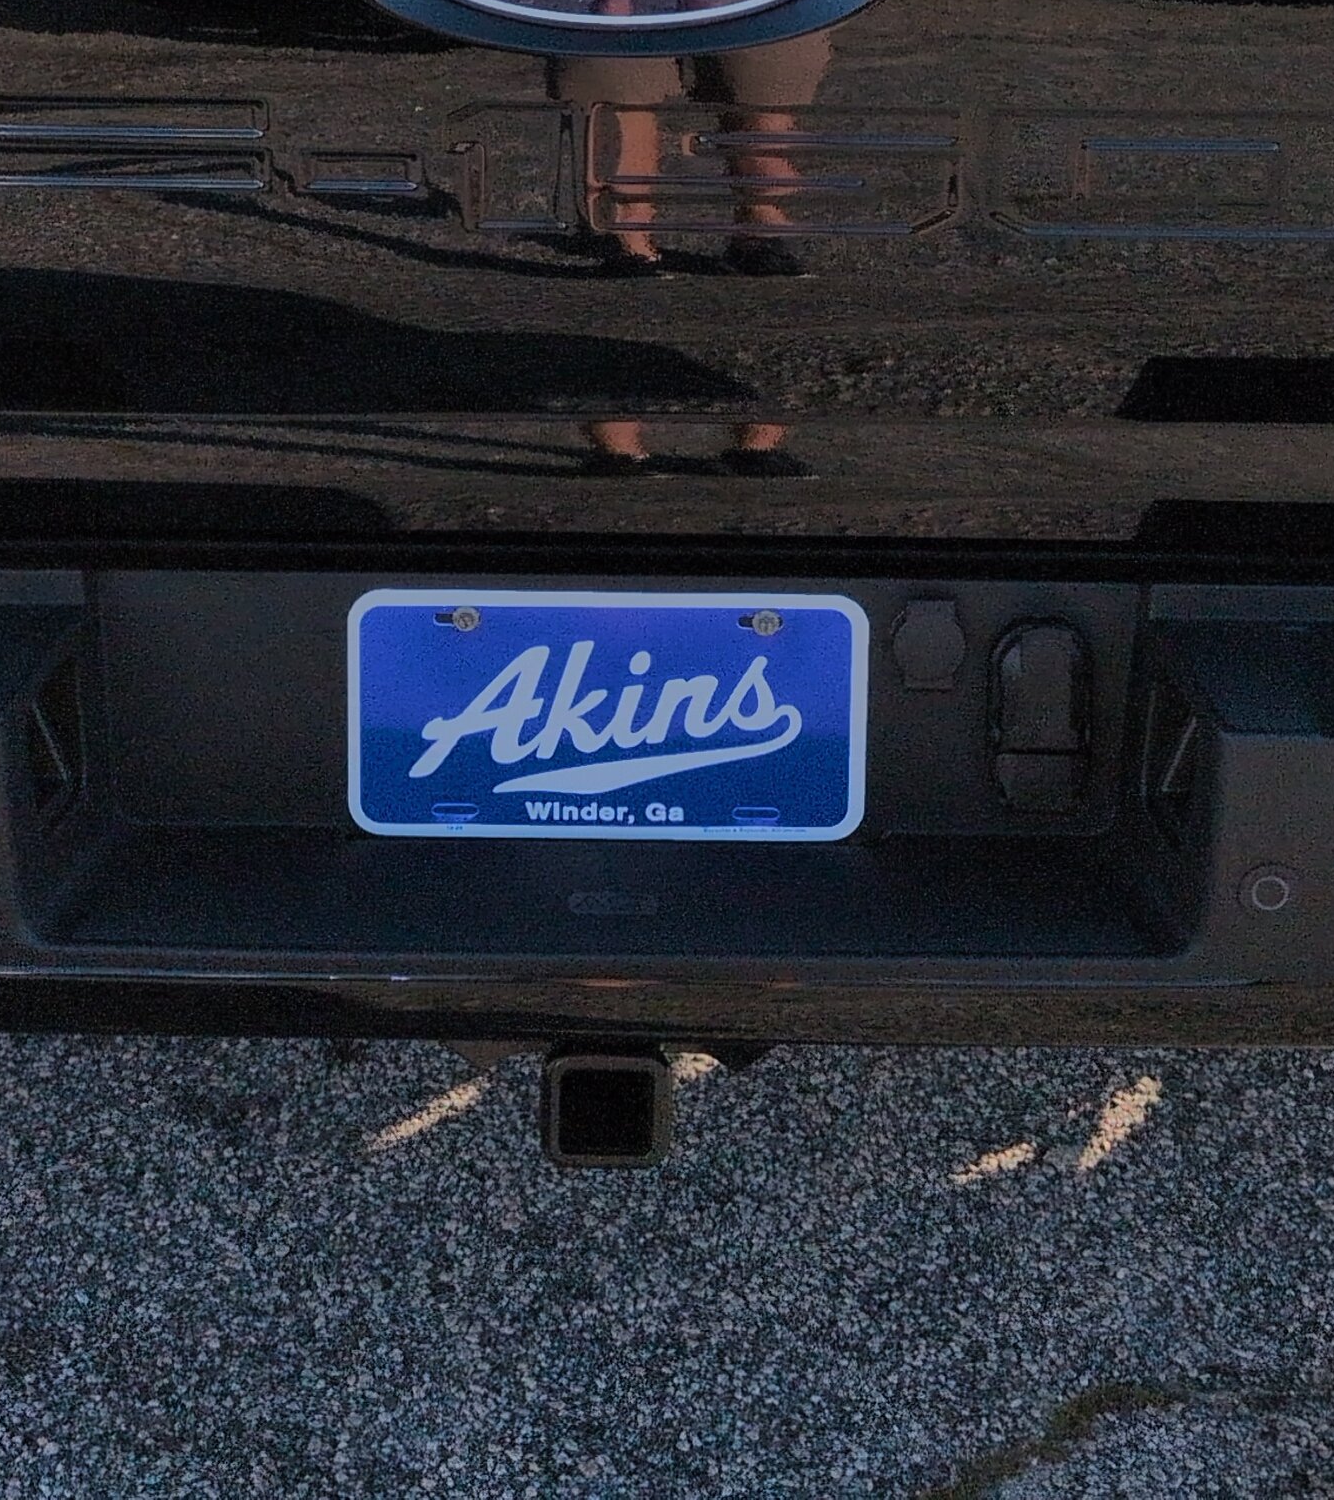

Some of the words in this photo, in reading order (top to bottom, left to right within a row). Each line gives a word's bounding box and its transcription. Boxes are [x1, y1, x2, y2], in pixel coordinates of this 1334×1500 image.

[409, 640, 802, 794] Akins
[525, 801, 635, 824] Winder,
[645, 803, 685, 821] Ga
